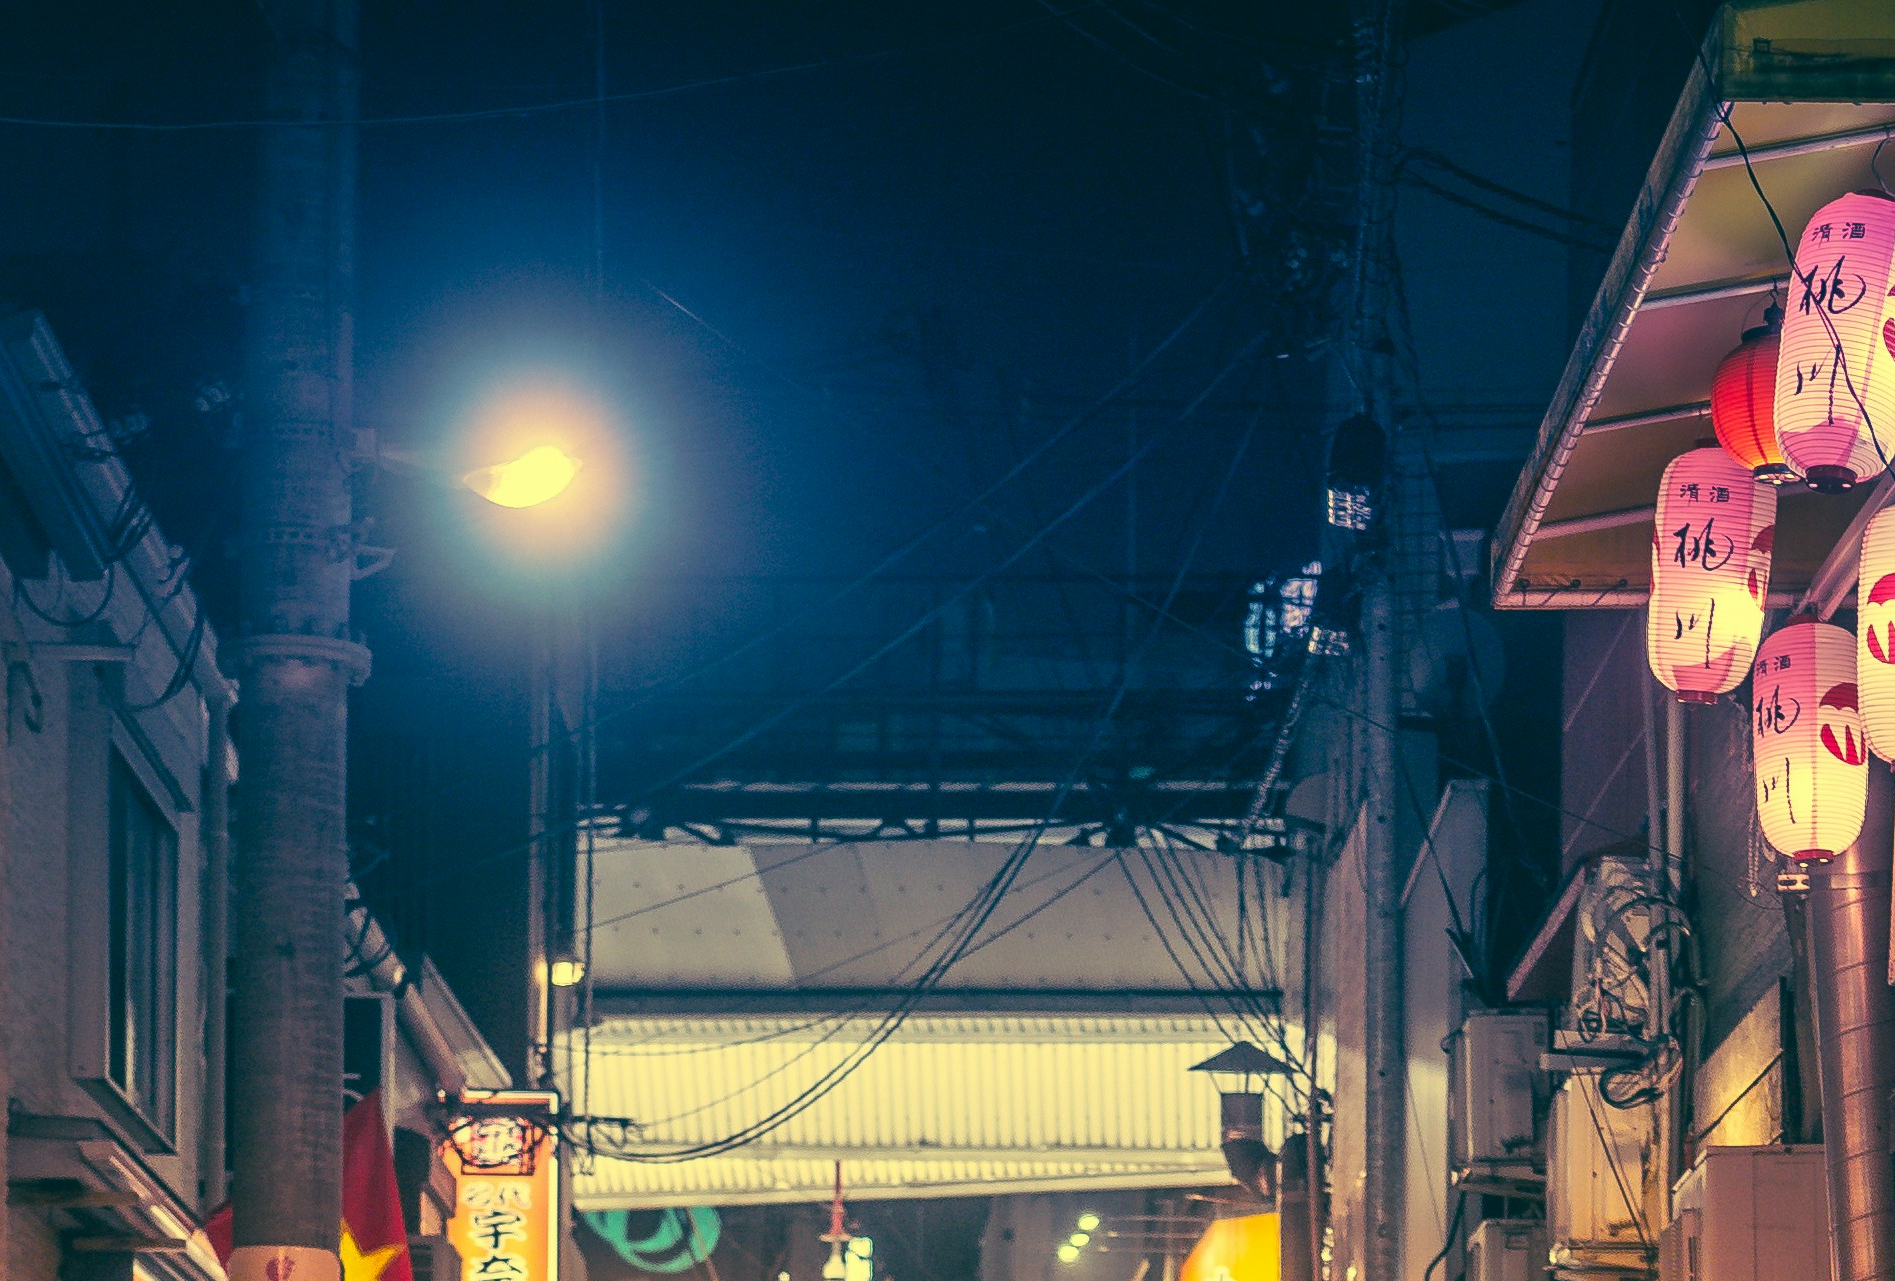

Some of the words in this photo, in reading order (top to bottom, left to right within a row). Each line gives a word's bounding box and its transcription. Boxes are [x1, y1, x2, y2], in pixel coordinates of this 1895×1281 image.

[1811, 221, 1866, 243] 清酒
[1795, 255, 1867, 426] 桃川
[1679, 482, 1731, 504] 清酒
[1672, 518, 1735, 671] 桃川
[1756, 687, 1801, 825] 桃川
